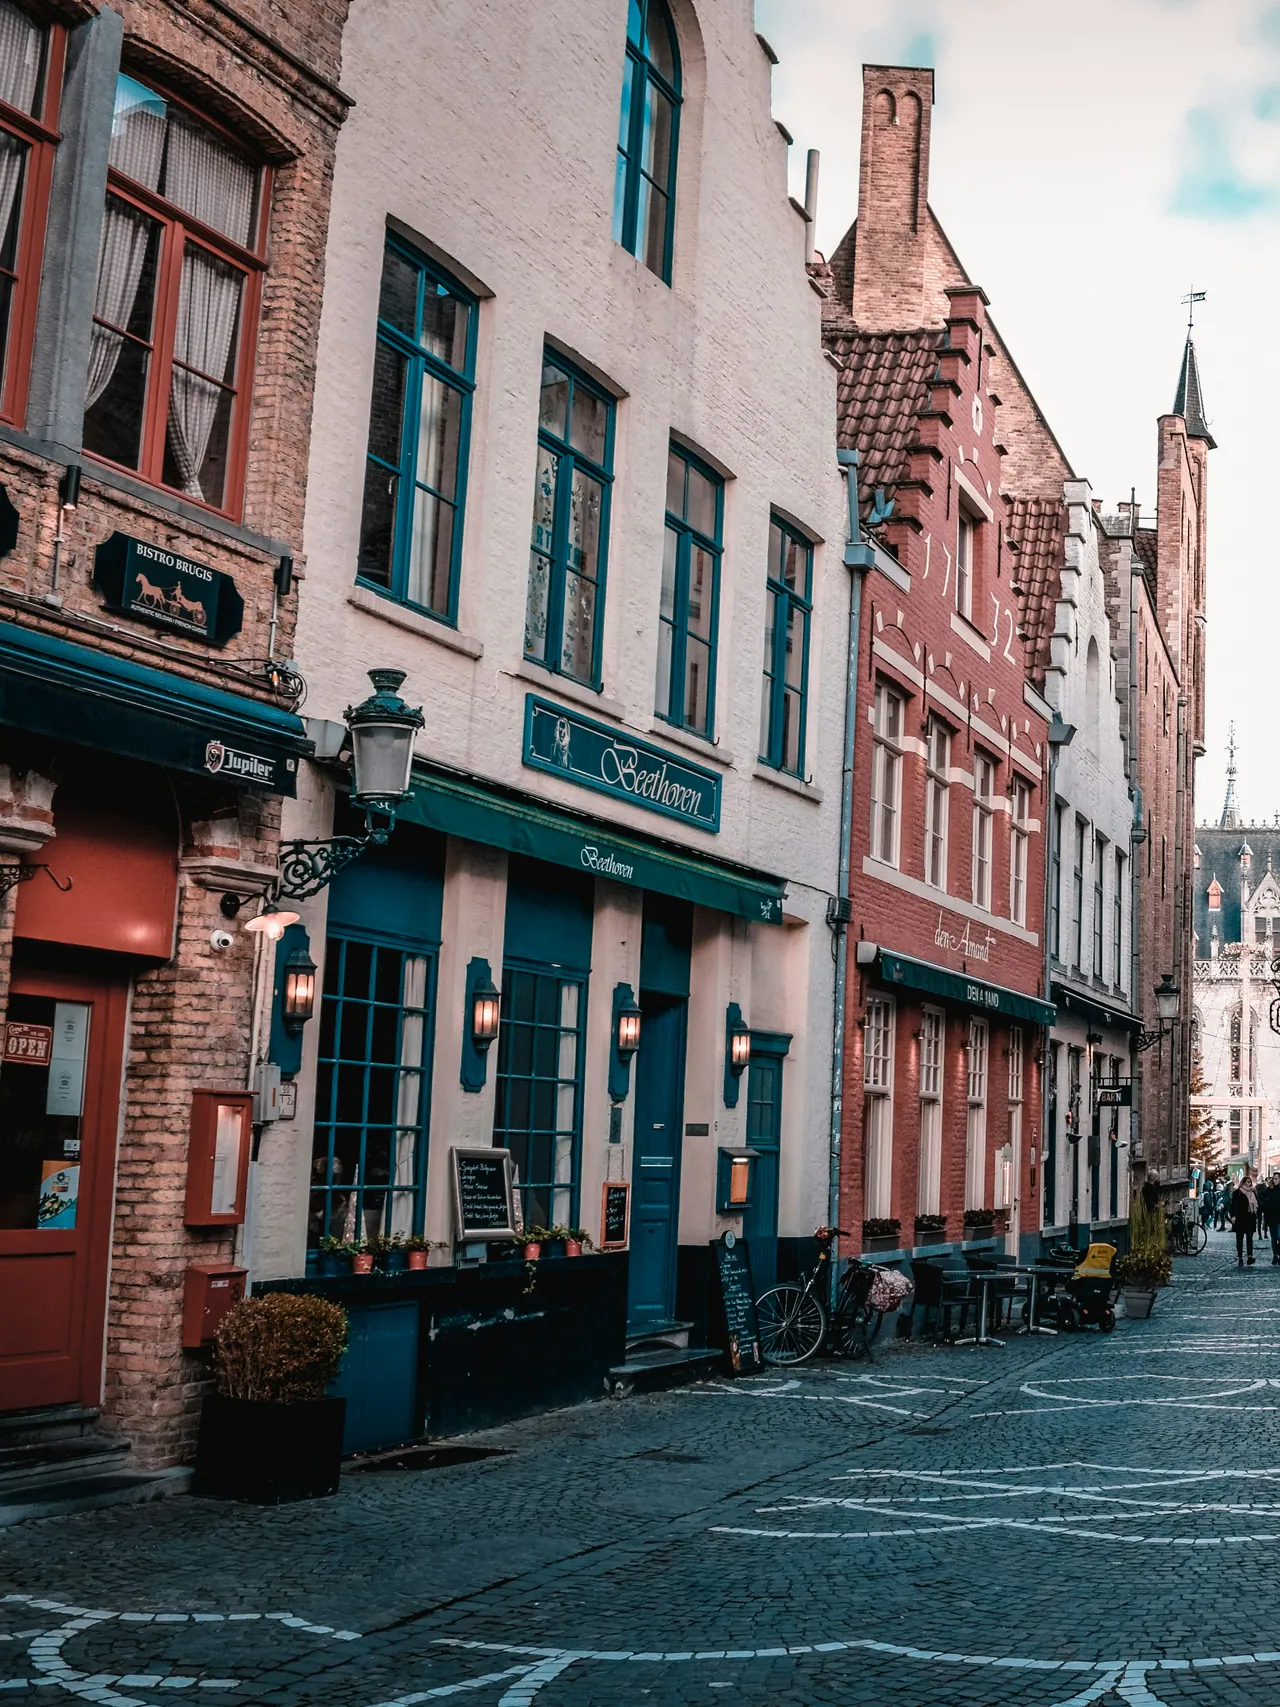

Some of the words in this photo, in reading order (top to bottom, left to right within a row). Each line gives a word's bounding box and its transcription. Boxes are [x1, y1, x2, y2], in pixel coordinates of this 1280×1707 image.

[137, 543, 174, 567] BISTRO
[175, 558, 213, 582] BRUGIS
[130, 604, 155, 617] AUTHENTIC
[174, 620, 191, 629] FRENCH
[191, 625, 208, 636] CUISINE
[223, 751, 273, 777] Jupiler
[600, 739, 702, 816] Beethoven
[580, 844, 634, 879] Beethoven
[934, 909, 950, 949] den
[967, 984, 979, 1002] DEN
[8, 1037, 47, 1057] OPEN
